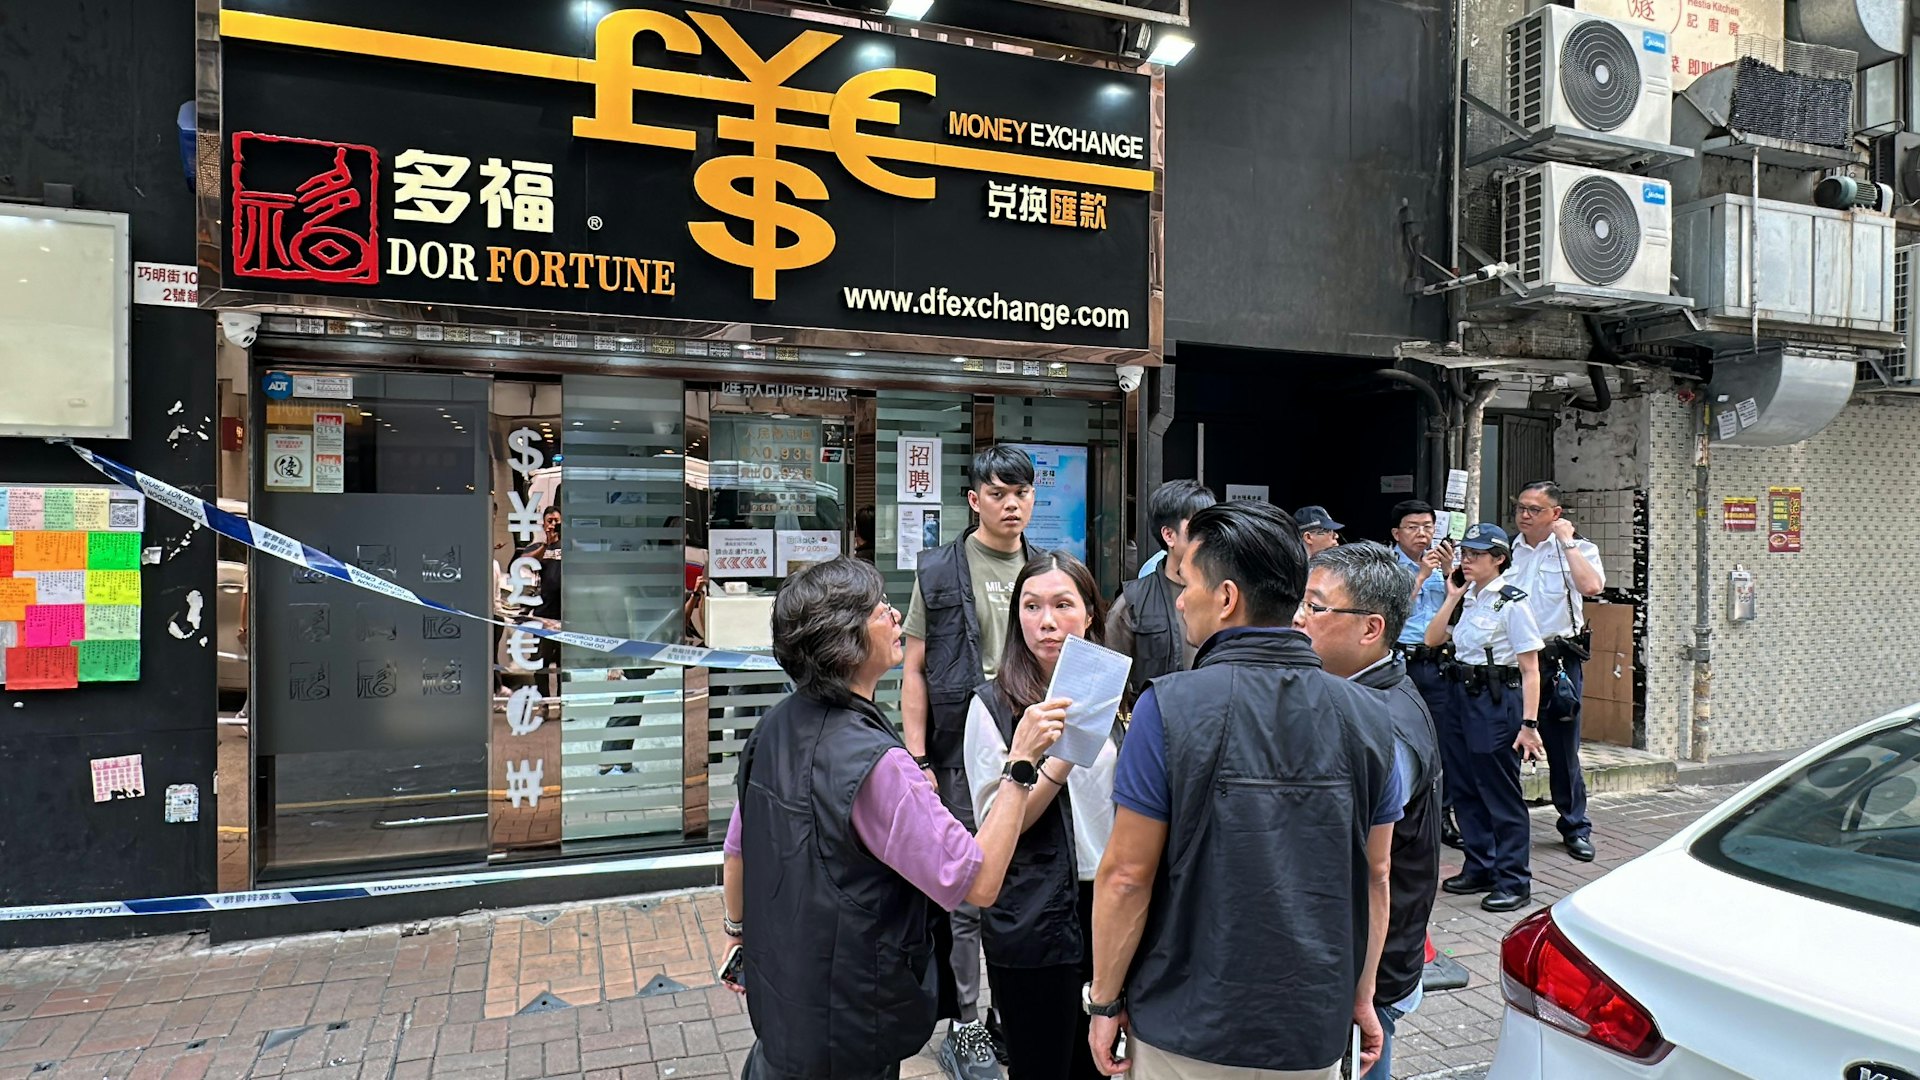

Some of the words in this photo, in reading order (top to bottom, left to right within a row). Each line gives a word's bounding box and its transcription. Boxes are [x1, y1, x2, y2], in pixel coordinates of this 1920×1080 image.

[1713, 2, 1740, 16] Kitchen
[949, 110, 1028, 144] MONEY
[1030, 123, 1144, 160] EXCHANGE
[393, 148, 554, 234] 多福
[137, 266, 181, 284] 巧明街
[386, 237, 478, 281] DOR
[485, 245, 676, 297] FORTUNE
[843, 286, 1130, 332] www.dfexchange.com
[267, 380, 289, 392] ADT
[908, 445, 931, 493] 招聘
[139, 476, 165, 492] CROSS
[146, 489, 177, 508] CORDON
[166, 490, 183, 500] NOT
[182, 496, 195, 506] DO
[178, 504, 204, 520] POLICE
[351, 569, 376, 582] CROSS
[985, 581, 1016, 593] MIL-S
